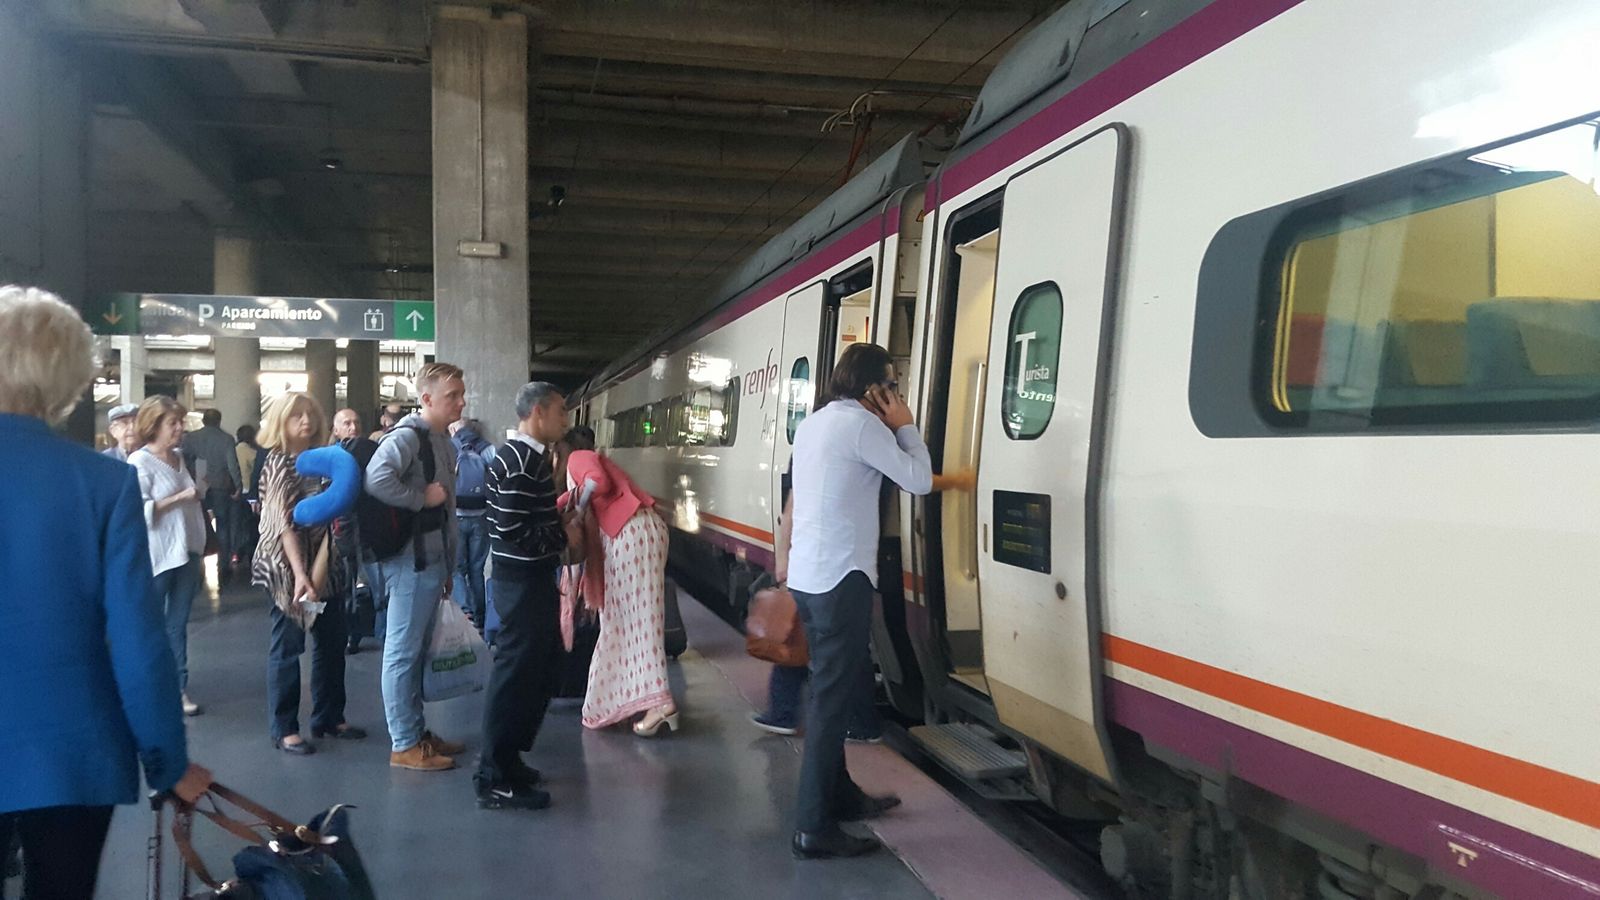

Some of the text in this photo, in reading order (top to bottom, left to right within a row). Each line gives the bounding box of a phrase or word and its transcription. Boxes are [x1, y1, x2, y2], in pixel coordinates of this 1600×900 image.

[221, 305, 322, 320] Aparcamiento
[743, 347, 778, 409] renfe
[1015, 331, 1049, 394] Turista
